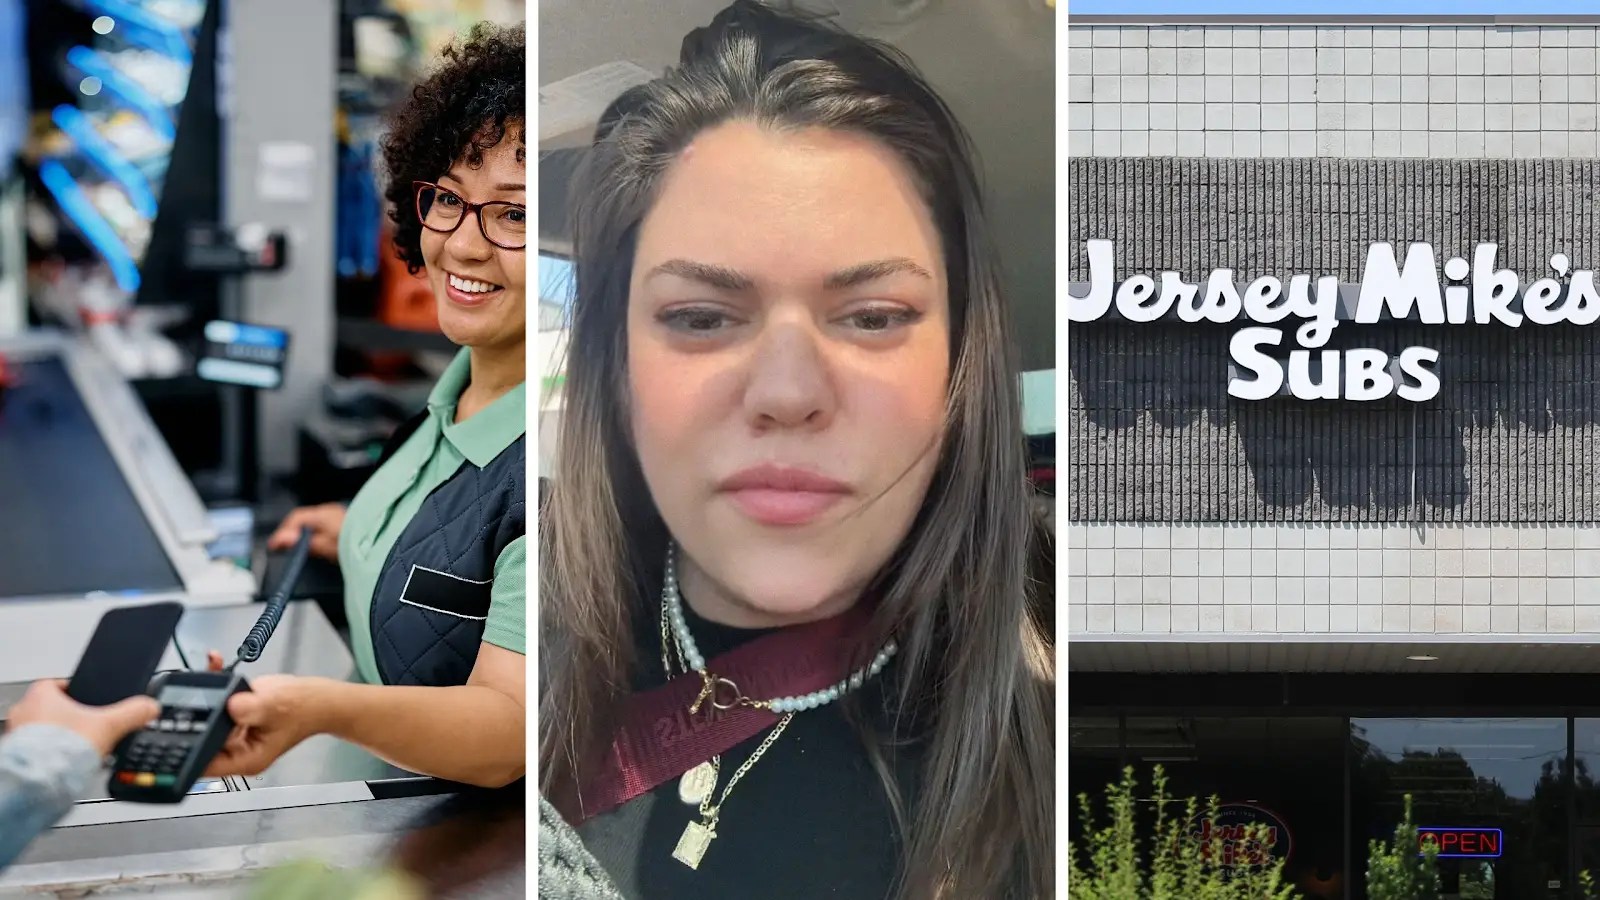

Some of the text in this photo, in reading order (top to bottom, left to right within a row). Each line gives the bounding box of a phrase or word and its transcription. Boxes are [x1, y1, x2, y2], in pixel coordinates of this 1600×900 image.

[1068, 238, 1600, 348] Jersey Mike's
[1192, 818, 1277, 846] Jrsy
[1419, 832, 1497, 853] OPEN
